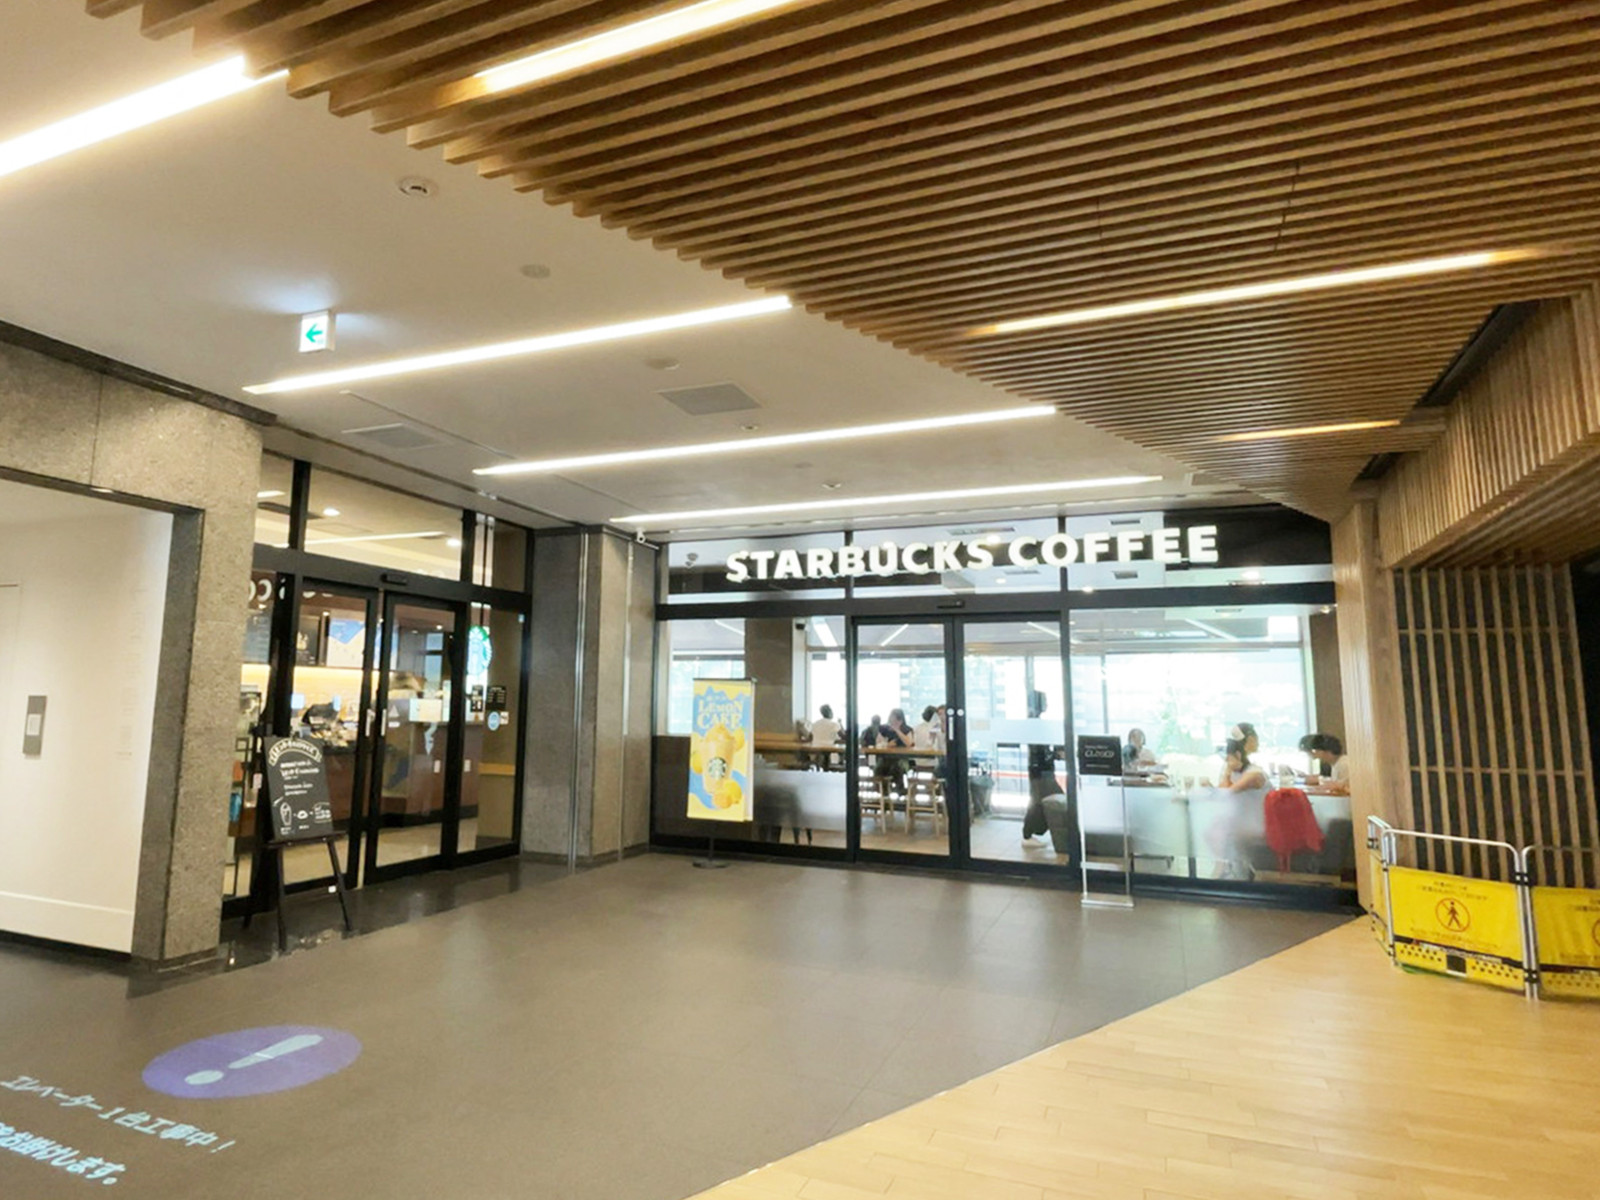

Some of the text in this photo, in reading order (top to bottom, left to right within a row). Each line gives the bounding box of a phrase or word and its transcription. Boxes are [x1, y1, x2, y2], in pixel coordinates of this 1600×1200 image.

[726, 525, 1218, 582] STARBUCKS COFFEE
[697, 713, 742, 729] CAKE
